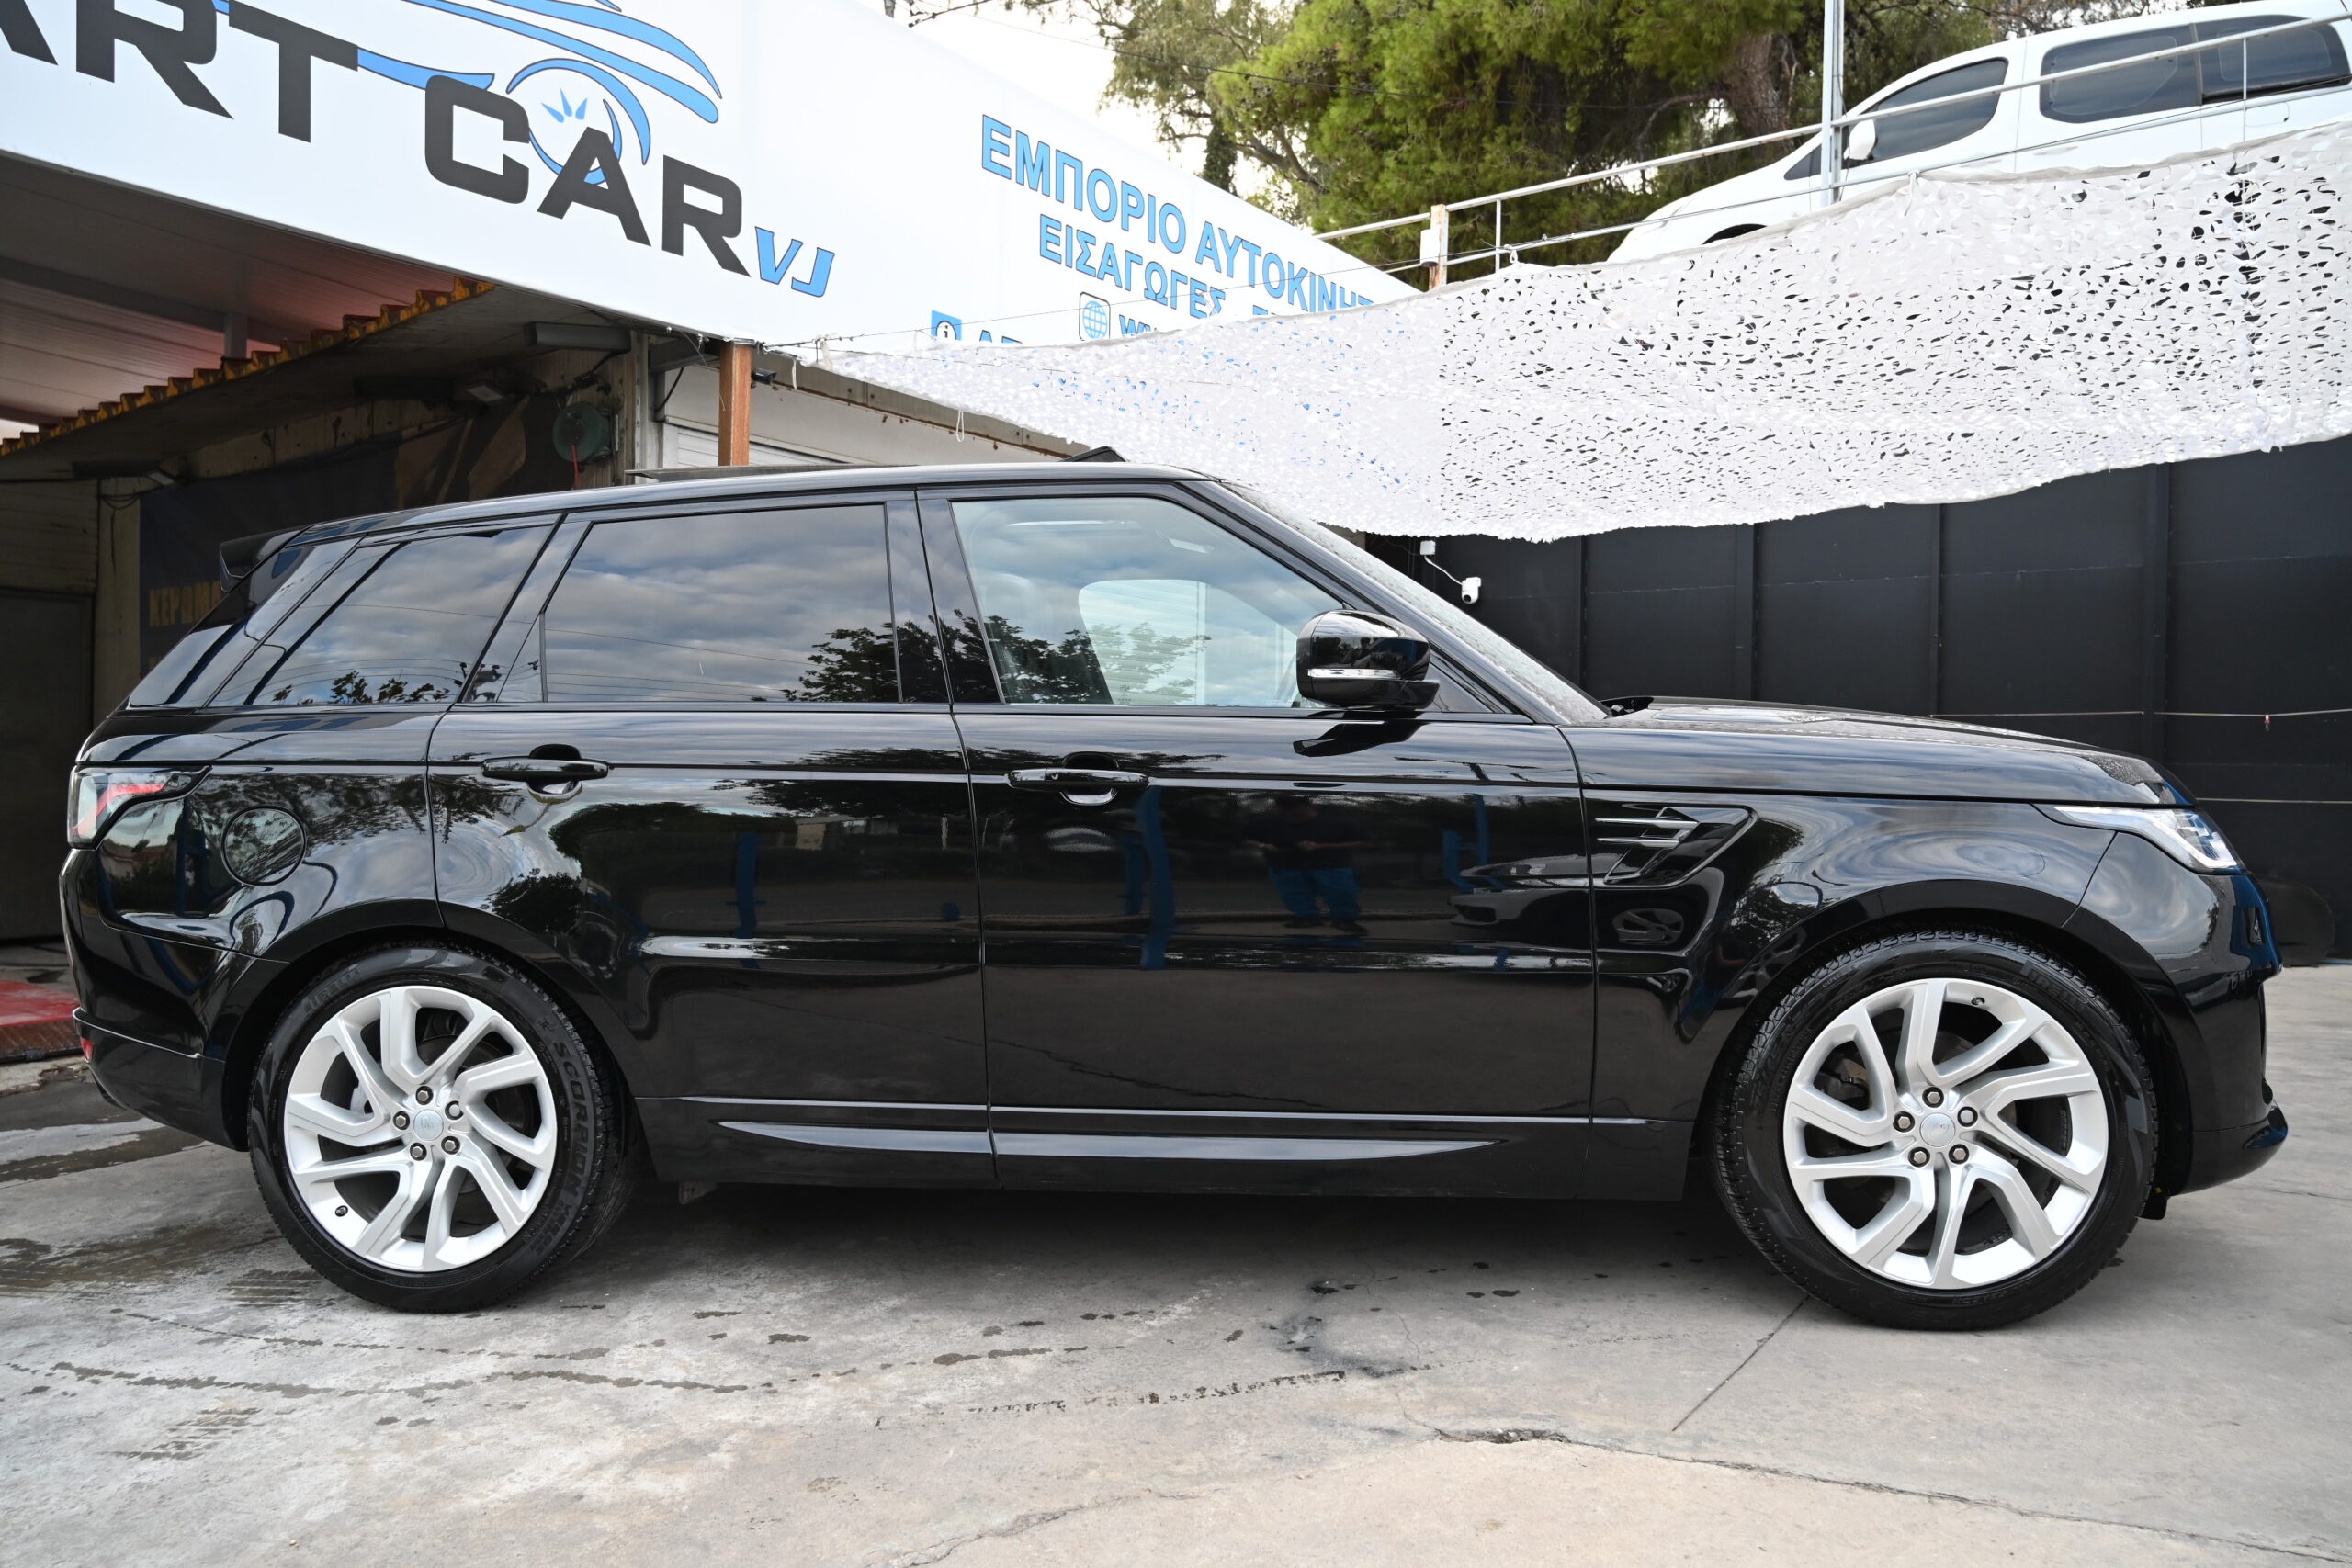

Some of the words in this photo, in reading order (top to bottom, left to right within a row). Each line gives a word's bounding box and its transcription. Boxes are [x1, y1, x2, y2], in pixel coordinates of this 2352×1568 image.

[0, 0, 358, 143] RT
[424, 74, 752, 277] CAR
[754, 226, 835, 298] VJ
[981, 113, 1187, 254] ΕΜΠΟΡΙΟ
[1194, 220, 1374, 314] ΑΥΤΟΚΙΝΗ
[553, 1041, 591, 1198] SCORPION
